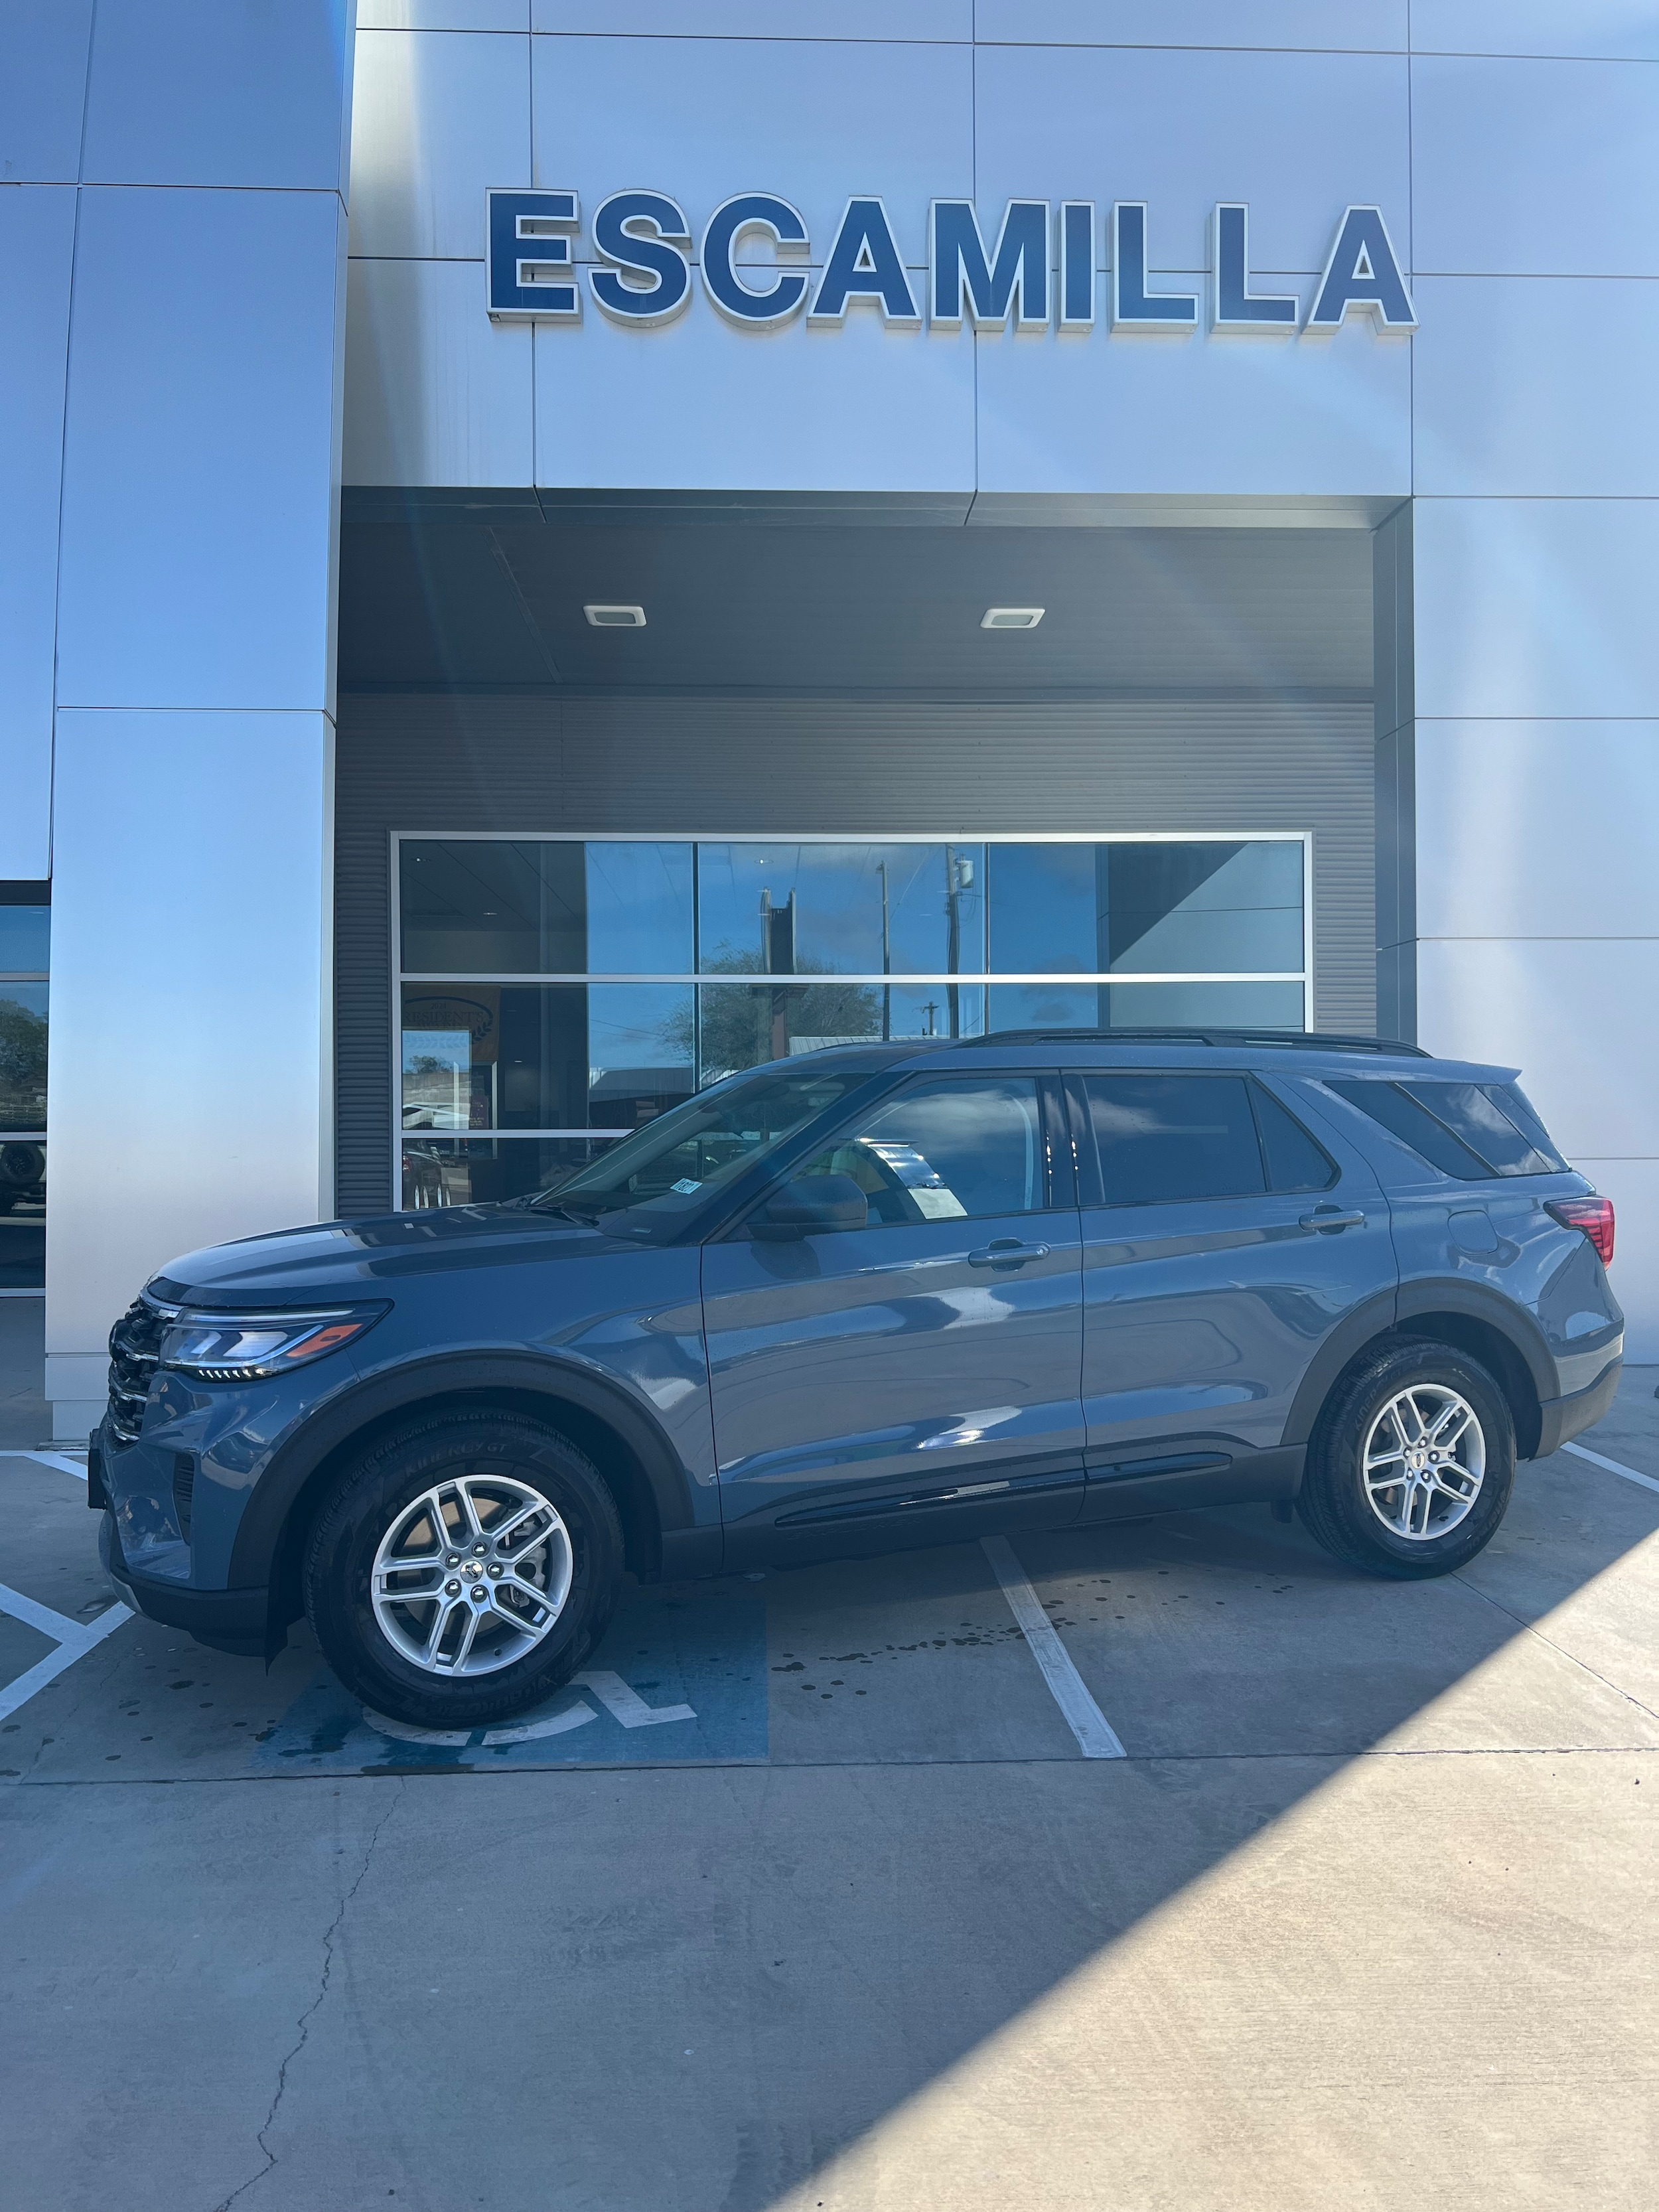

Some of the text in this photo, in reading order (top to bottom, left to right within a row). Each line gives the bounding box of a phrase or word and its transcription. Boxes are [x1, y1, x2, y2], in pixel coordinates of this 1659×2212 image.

[485, 188, 1420, 332] ESCAMILLA
[404, 1011, 484, 1023] RESIDENT'S
[486, 1443, 508, 1453] GT
